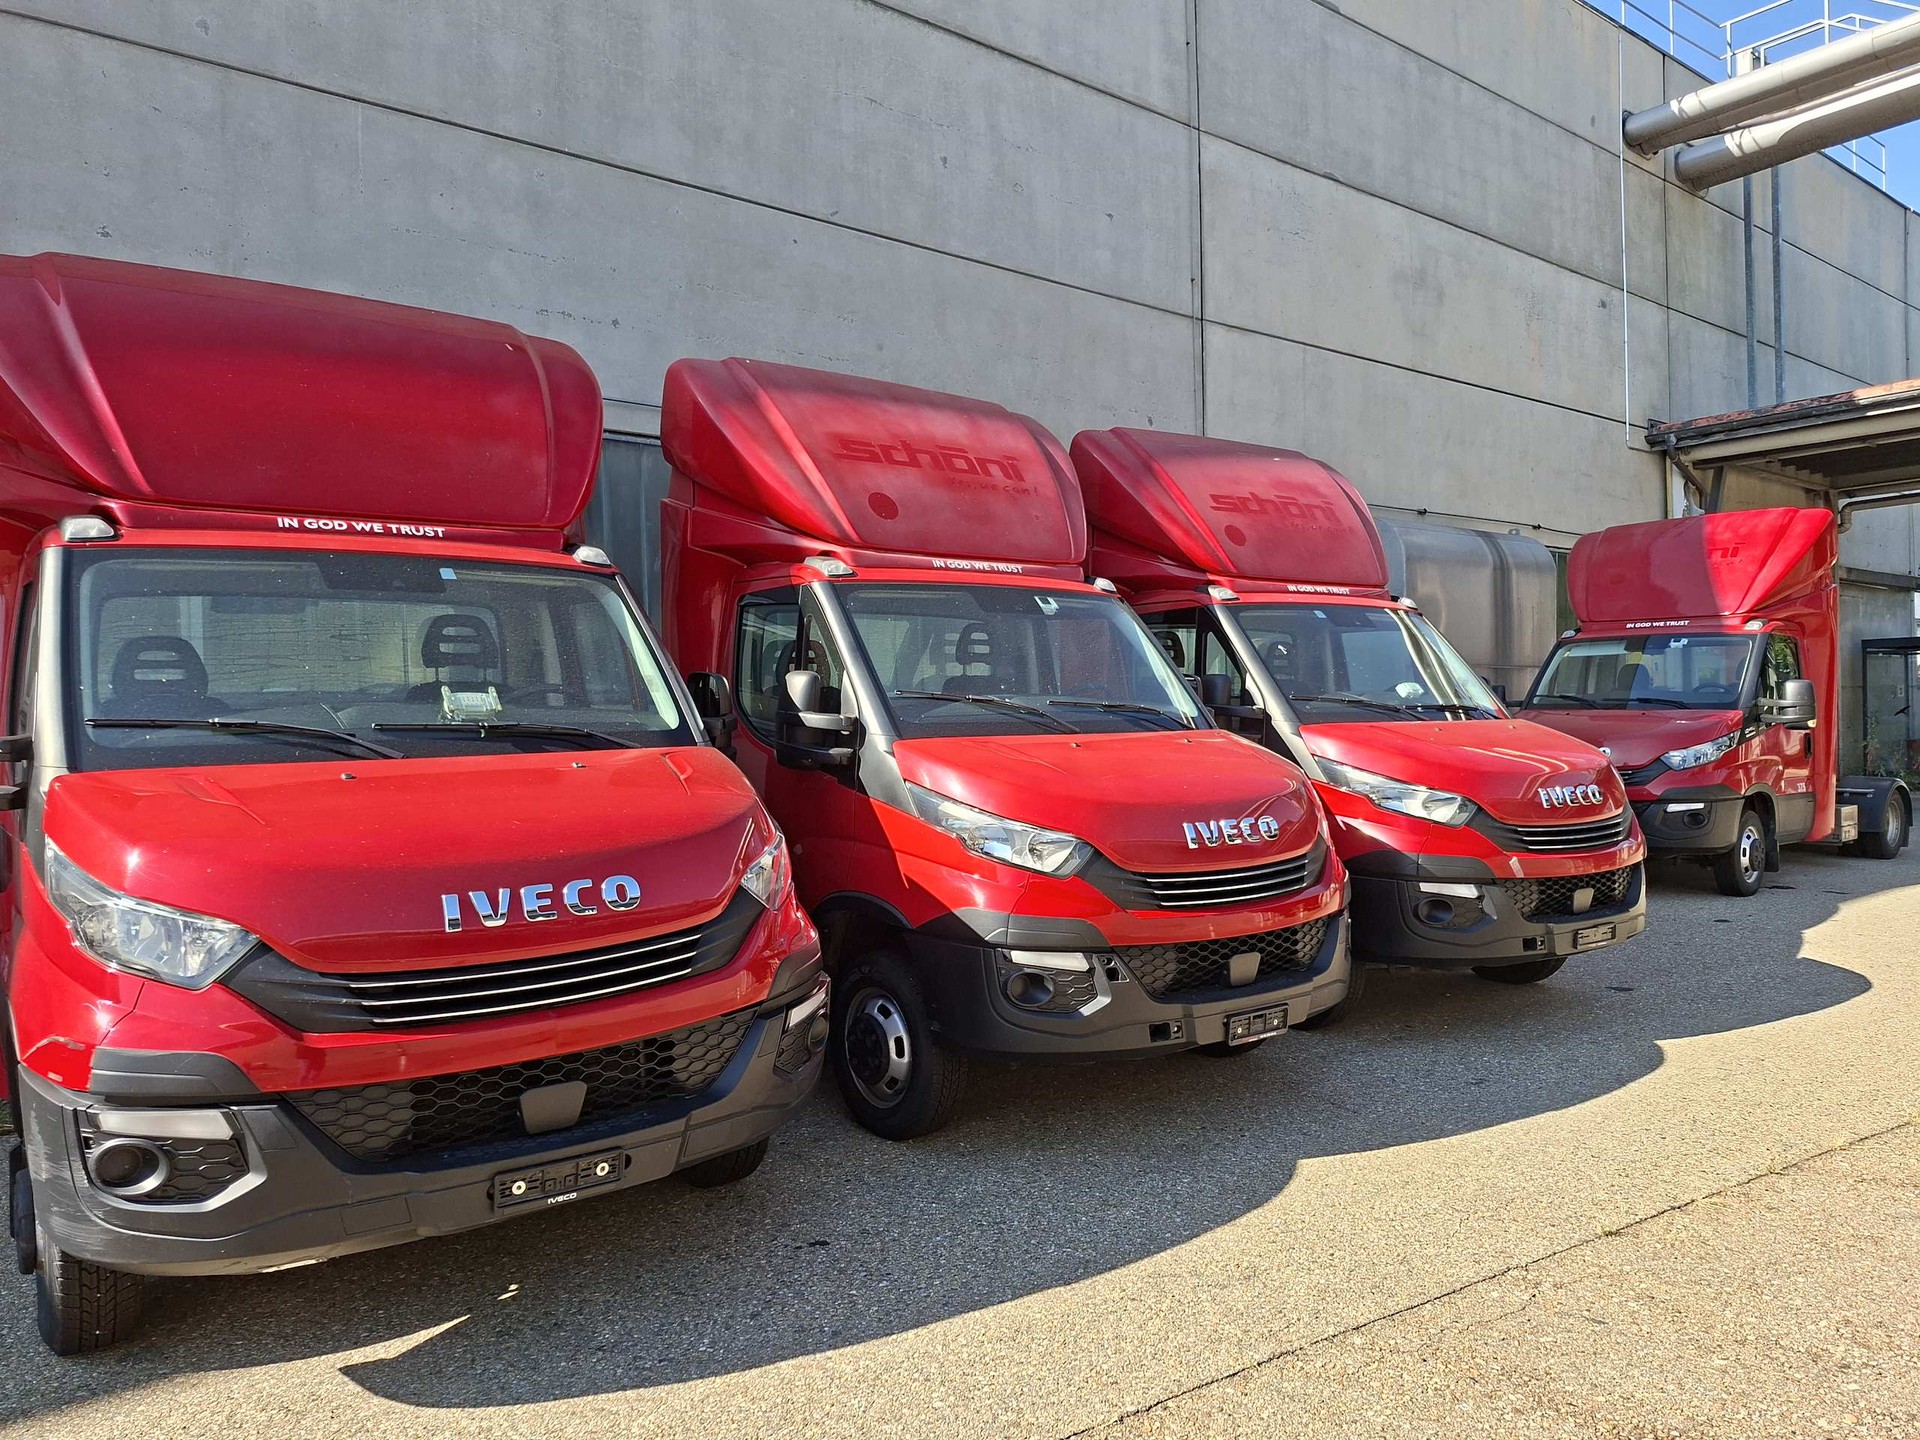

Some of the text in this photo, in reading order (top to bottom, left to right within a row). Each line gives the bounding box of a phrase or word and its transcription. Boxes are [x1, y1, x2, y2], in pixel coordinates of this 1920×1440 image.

[277, 517, 446, 538] IN GOD WE TRUST
[932, 559, 1023, 574] IN GOD WE TRUST
[1286, 584, 1350, 595] IN GOD WE TRUST
[1537, 784, 1604, 809] IVECO
[1182, 815, 1280, 850] IVECO
[440, 874, 641, 933] IVECO
[547, 1192, 578, 1205] IVECO
